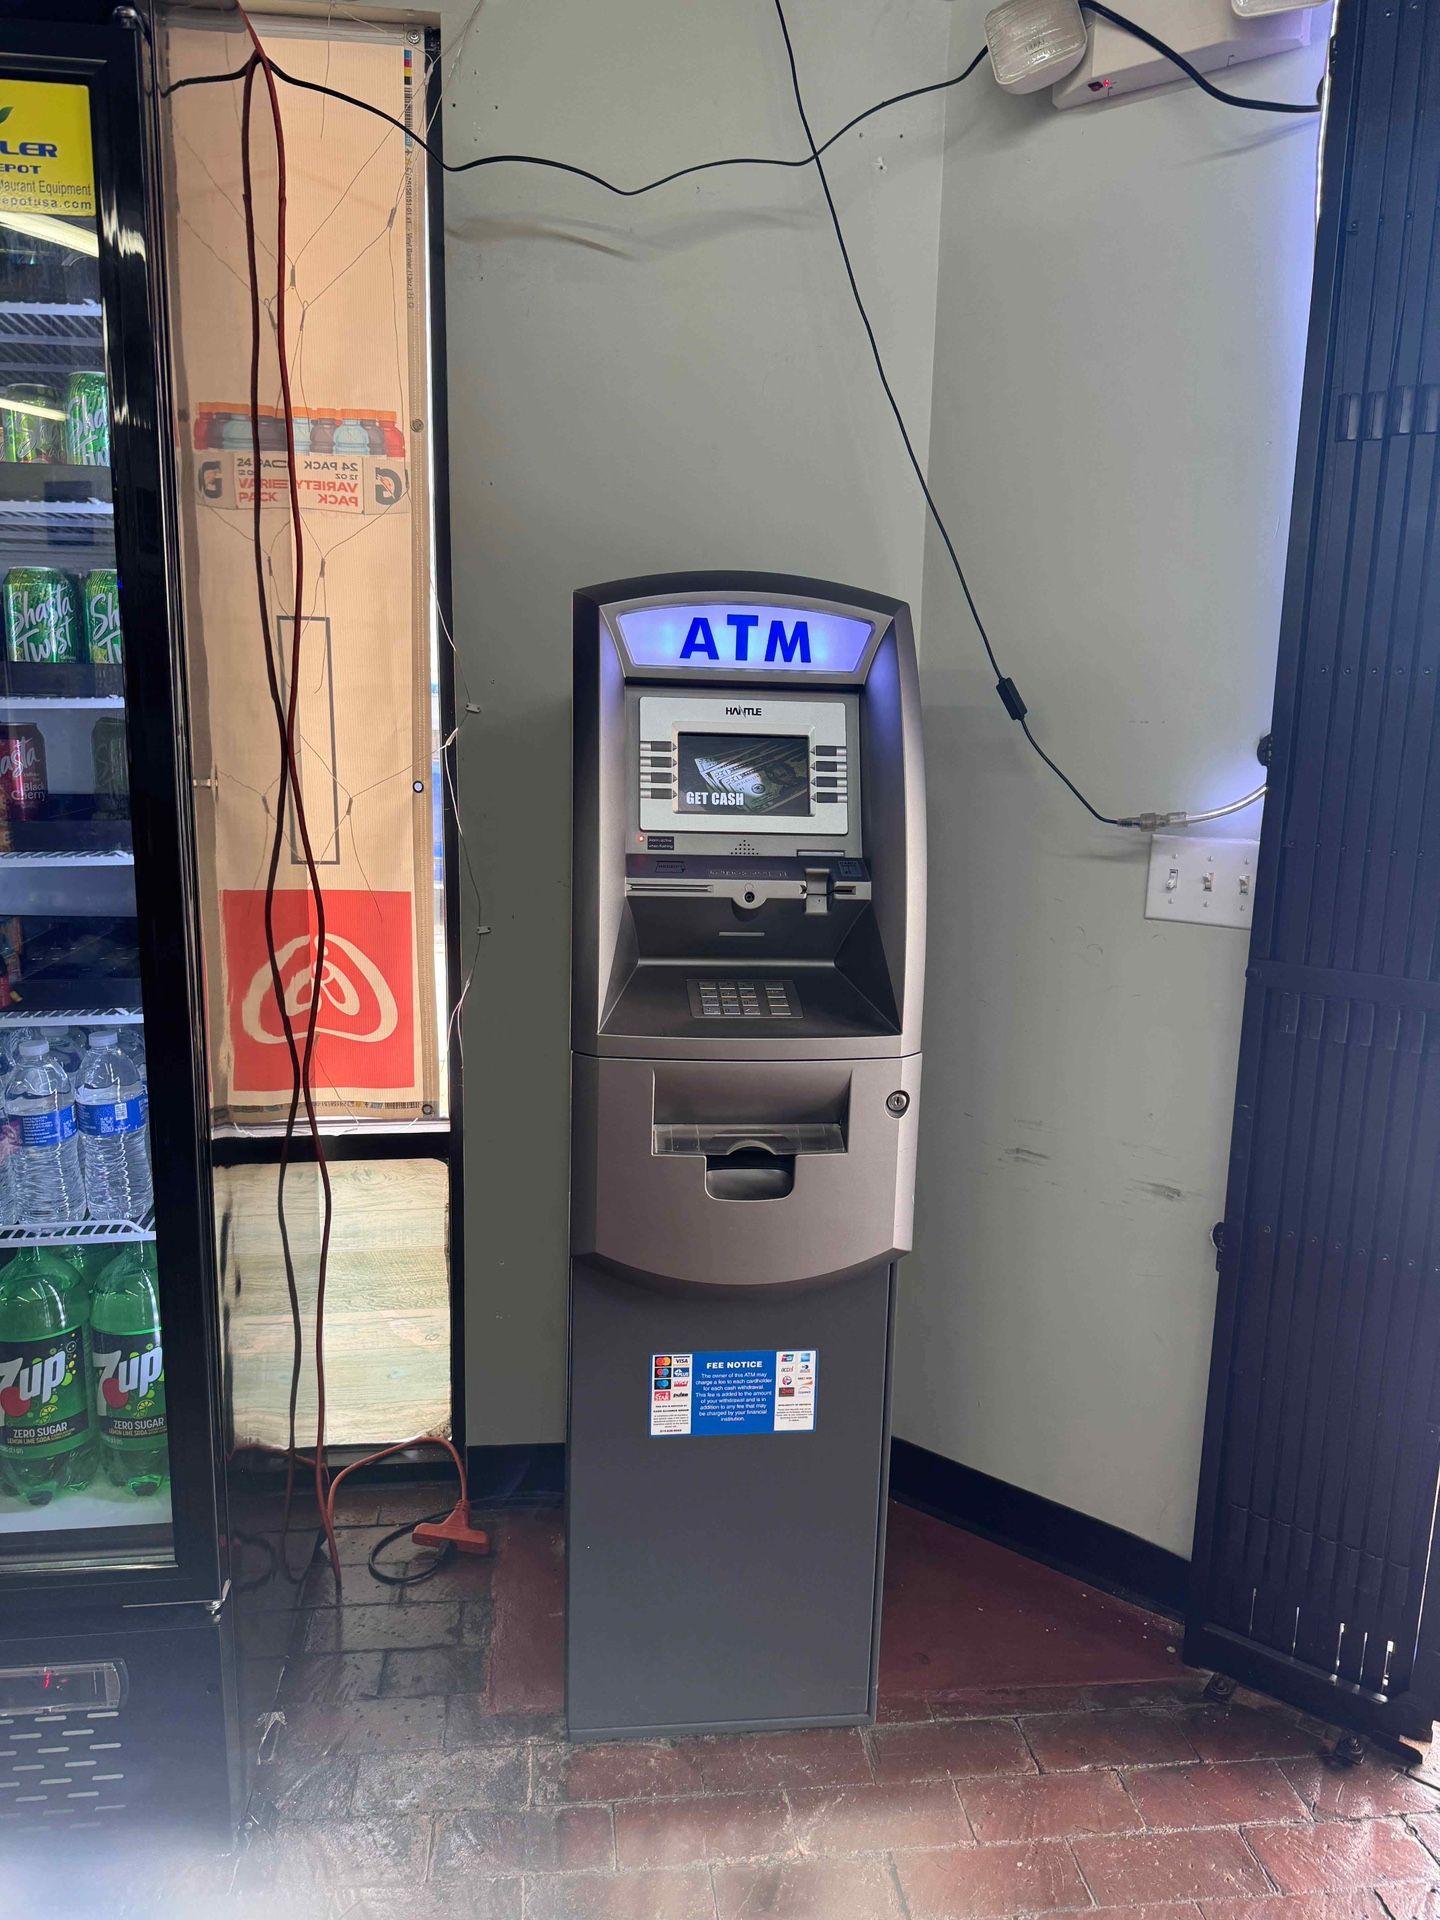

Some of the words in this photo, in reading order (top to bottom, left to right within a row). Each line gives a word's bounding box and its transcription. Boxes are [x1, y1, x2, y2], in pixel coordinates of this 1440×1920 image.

[39, 180, 92, 196] Equipment
[10, 583, 74, 636] Shasta
[680, 613, 812, 664] ATM
[0, 736, 40, 777] asta
[686, 791, 709, 805] GET
[711, 792, 744, 806] CASH
[727, 1361, 763, 1369] NOTICE
[93, 1346, 163, 1417] 7up
[13, 1429, 35, 1439] ZERO
[36, 1421, 68, 1437] SUGAR
[113, 1420, 133, 1430] ZERO
[134, 1417, 165, 1430] SUGAR
[36, 1435, 51, 1443] SODA
